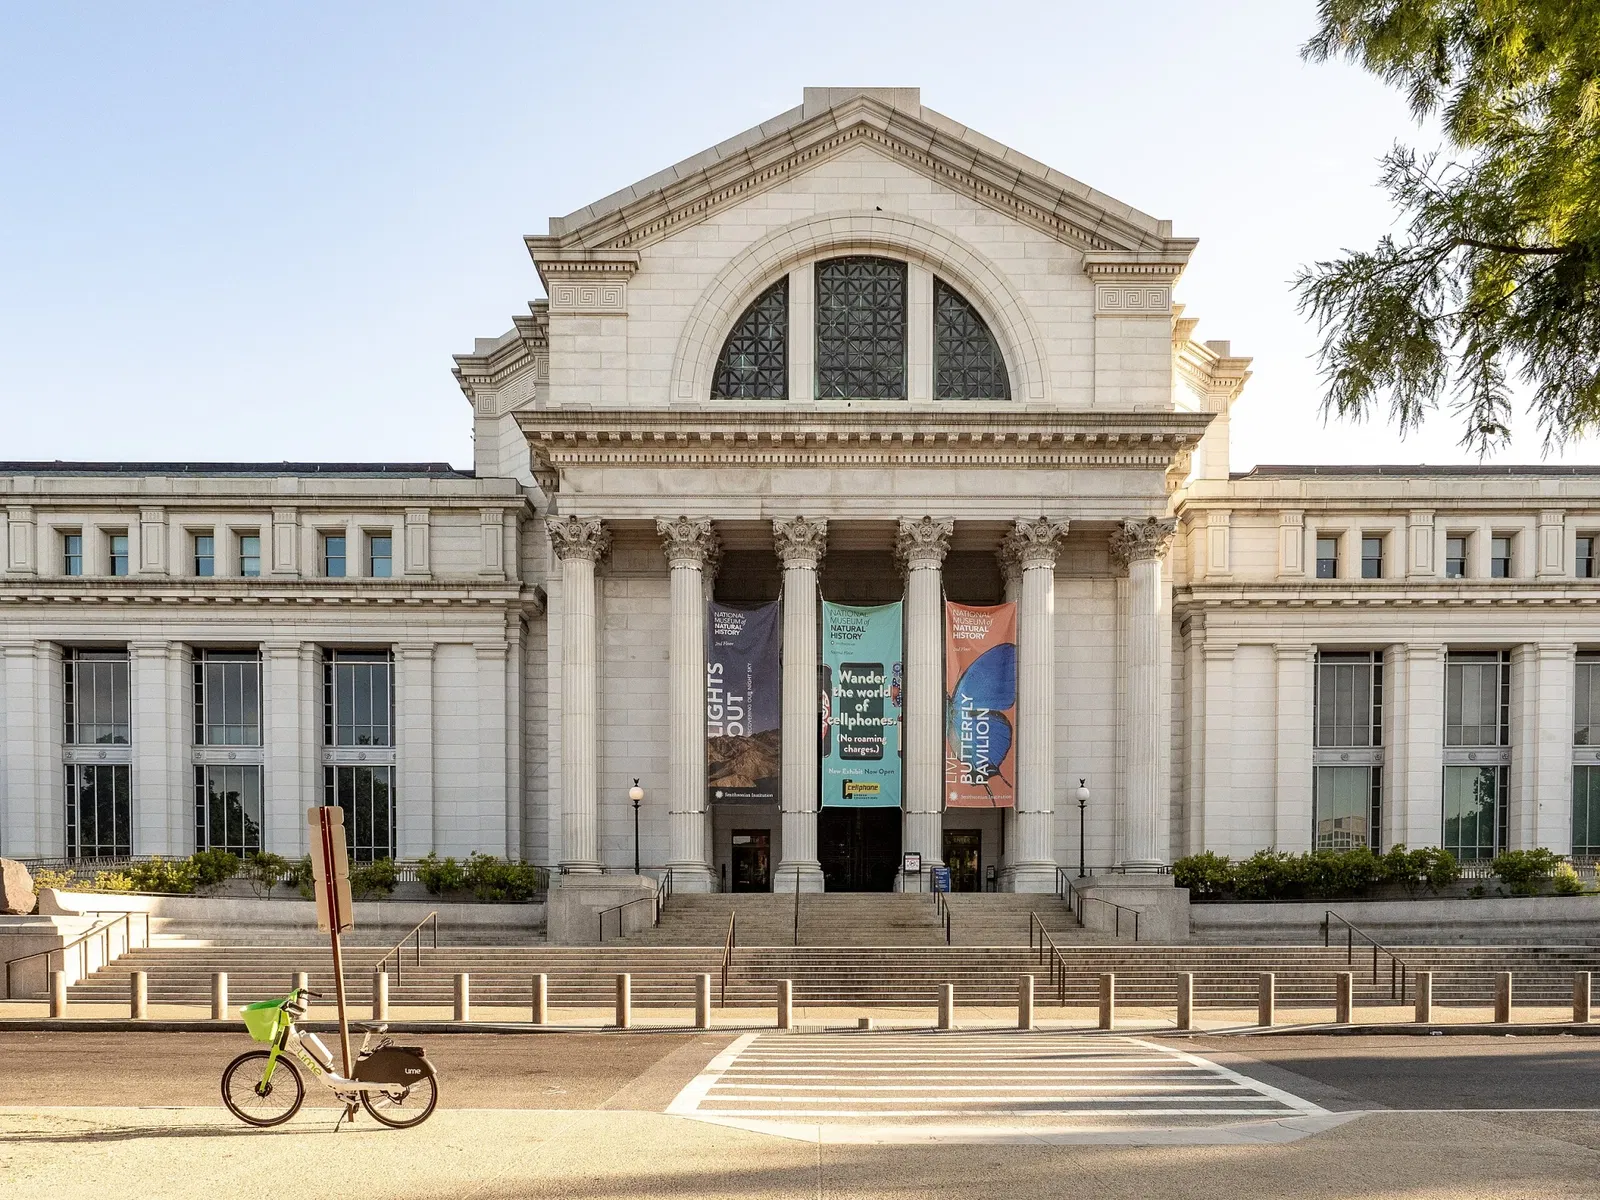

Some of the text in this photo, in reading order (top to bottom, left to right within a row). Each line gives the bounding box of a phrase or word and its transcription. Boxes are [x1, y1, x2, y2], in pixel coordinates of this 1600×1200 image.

[830, 609, 869, 618] NATIONAL
[952, 609, 992, 618] NATIONAL
[830, 624, 866, 632] NATURAL
[864, 618, 870, 626] of
[952, 617, 994, 628] MUSEUM of
[952, 624, 989, 632] NATURAL
[830, 632, 862, 640] HISTORY
[952, 632, 986, 640] HISTORY
[838, 670, 888, 684] Wander
[832, 684, 892, 698] the world
[708, 662, 724, 738] LIGHTS
[855, 698, 870, 712] of
[726, 692, 744, 737] OUT
[826, 712, 897, 730] cellphones.
[836, 733, 887, 745] (No roaming
[961, 693, 973, 784] BUTTERFLY
[843, 744, 880, 756] charges.)
[976, 708, 990, 784] PAVILION
[946, 752, 958, 783] LIVE
[847, 784, 878, 792] cellphone
[296, 1050, 322, 1077] Lime
